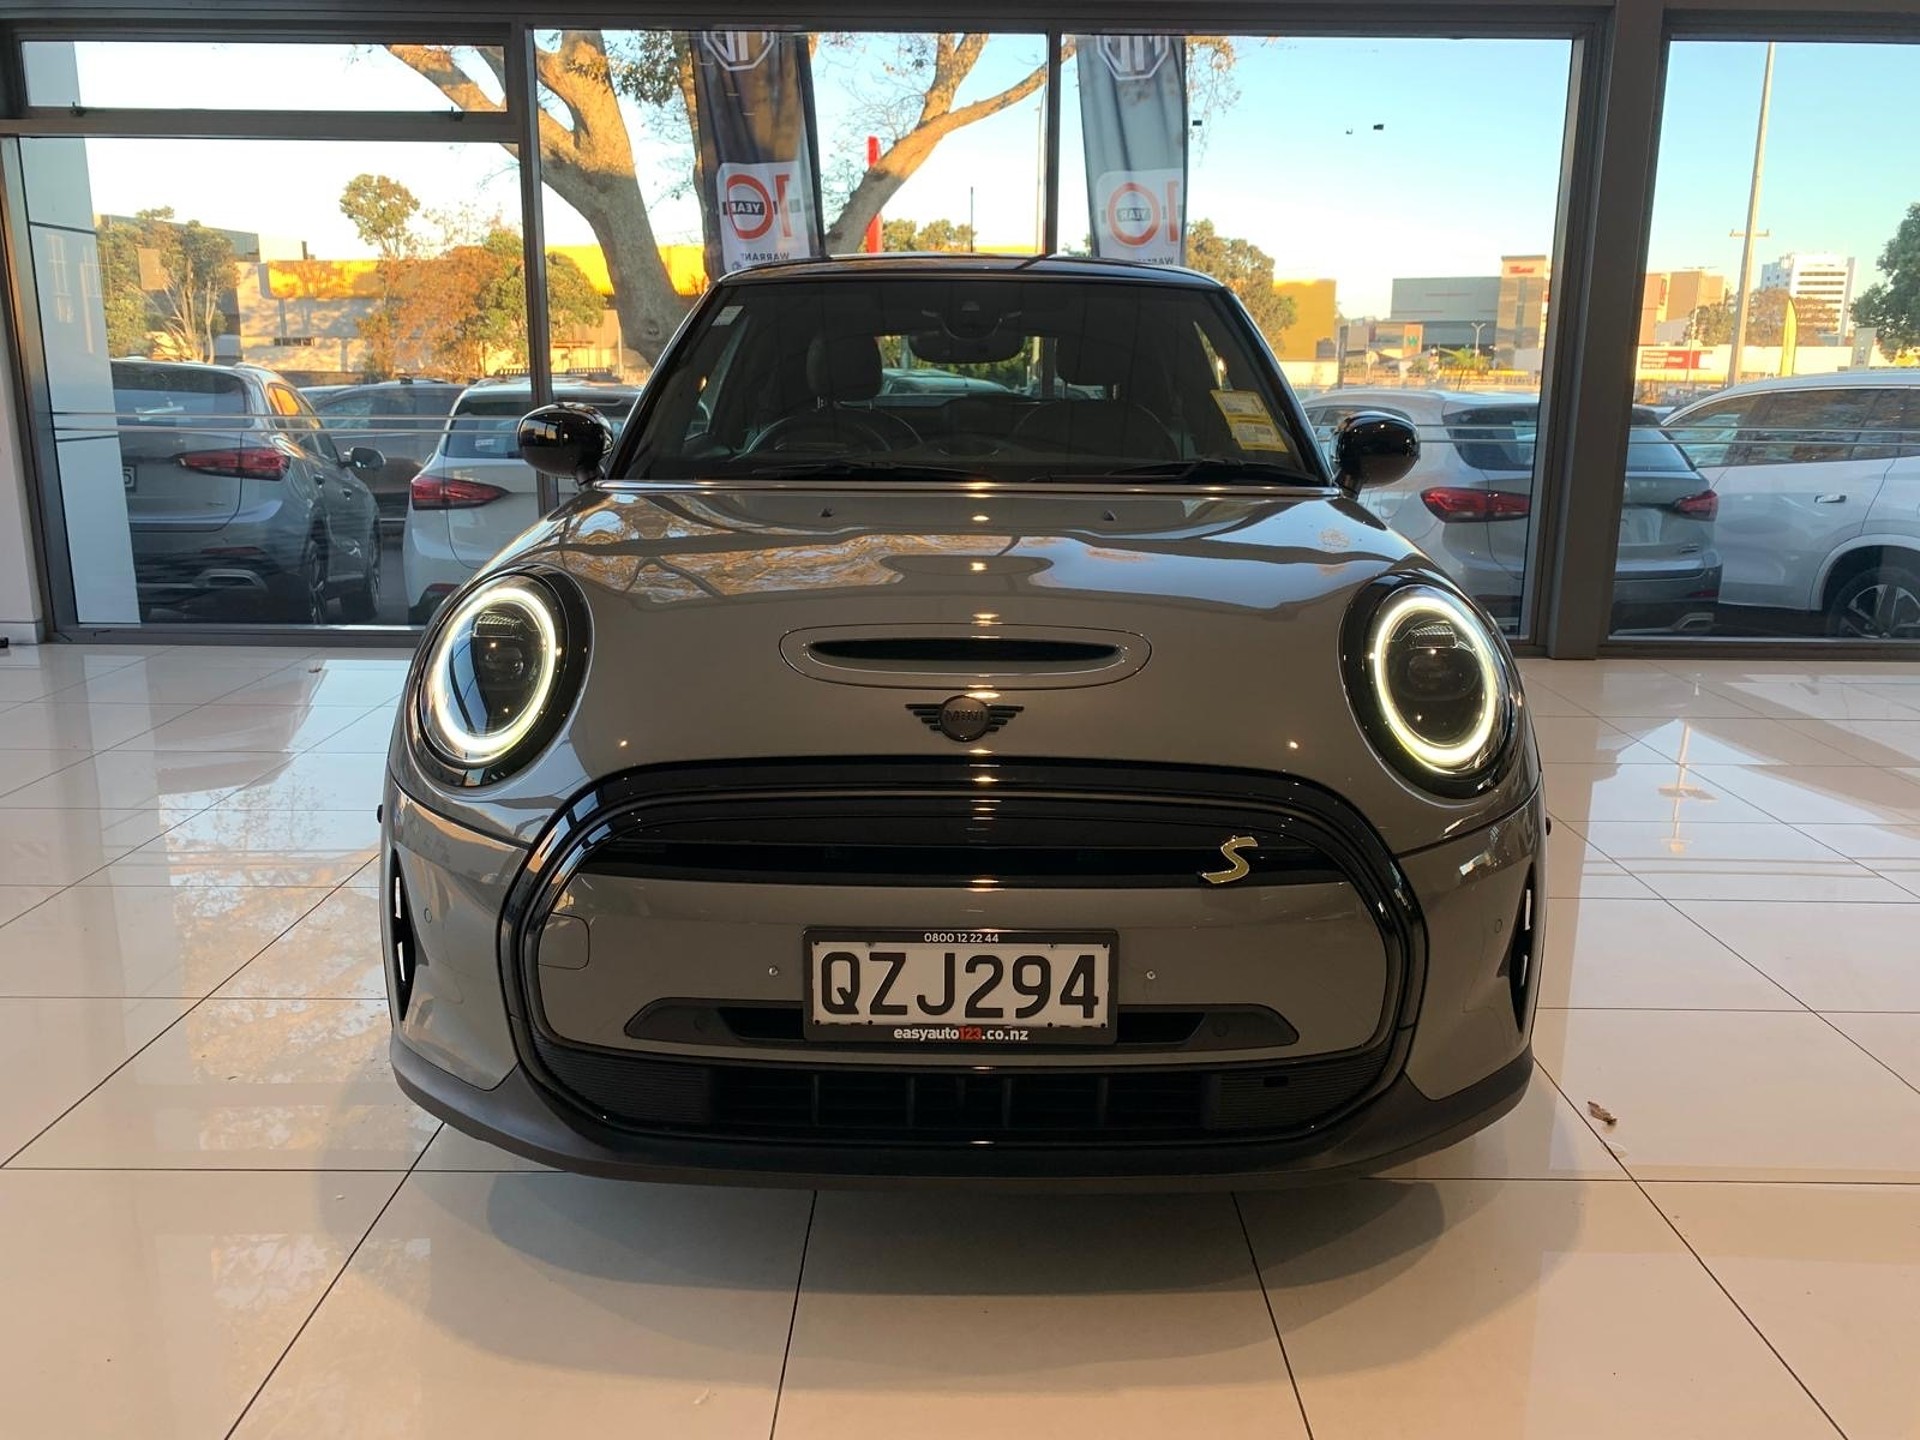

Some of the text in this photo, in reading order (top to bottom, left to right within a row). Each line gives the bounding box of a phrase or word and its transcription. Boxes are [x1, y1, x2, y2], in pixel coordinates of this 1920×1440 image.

[944, 710, 985, 722] MINI
[1201, 835, 1259, 885] S
[924, 933, 999, 943] 0800 12 22 44
[821, 951, 1099, 1019] QZJ294
[893, 1026, 1029, 1041] easyauto123.co.nz
